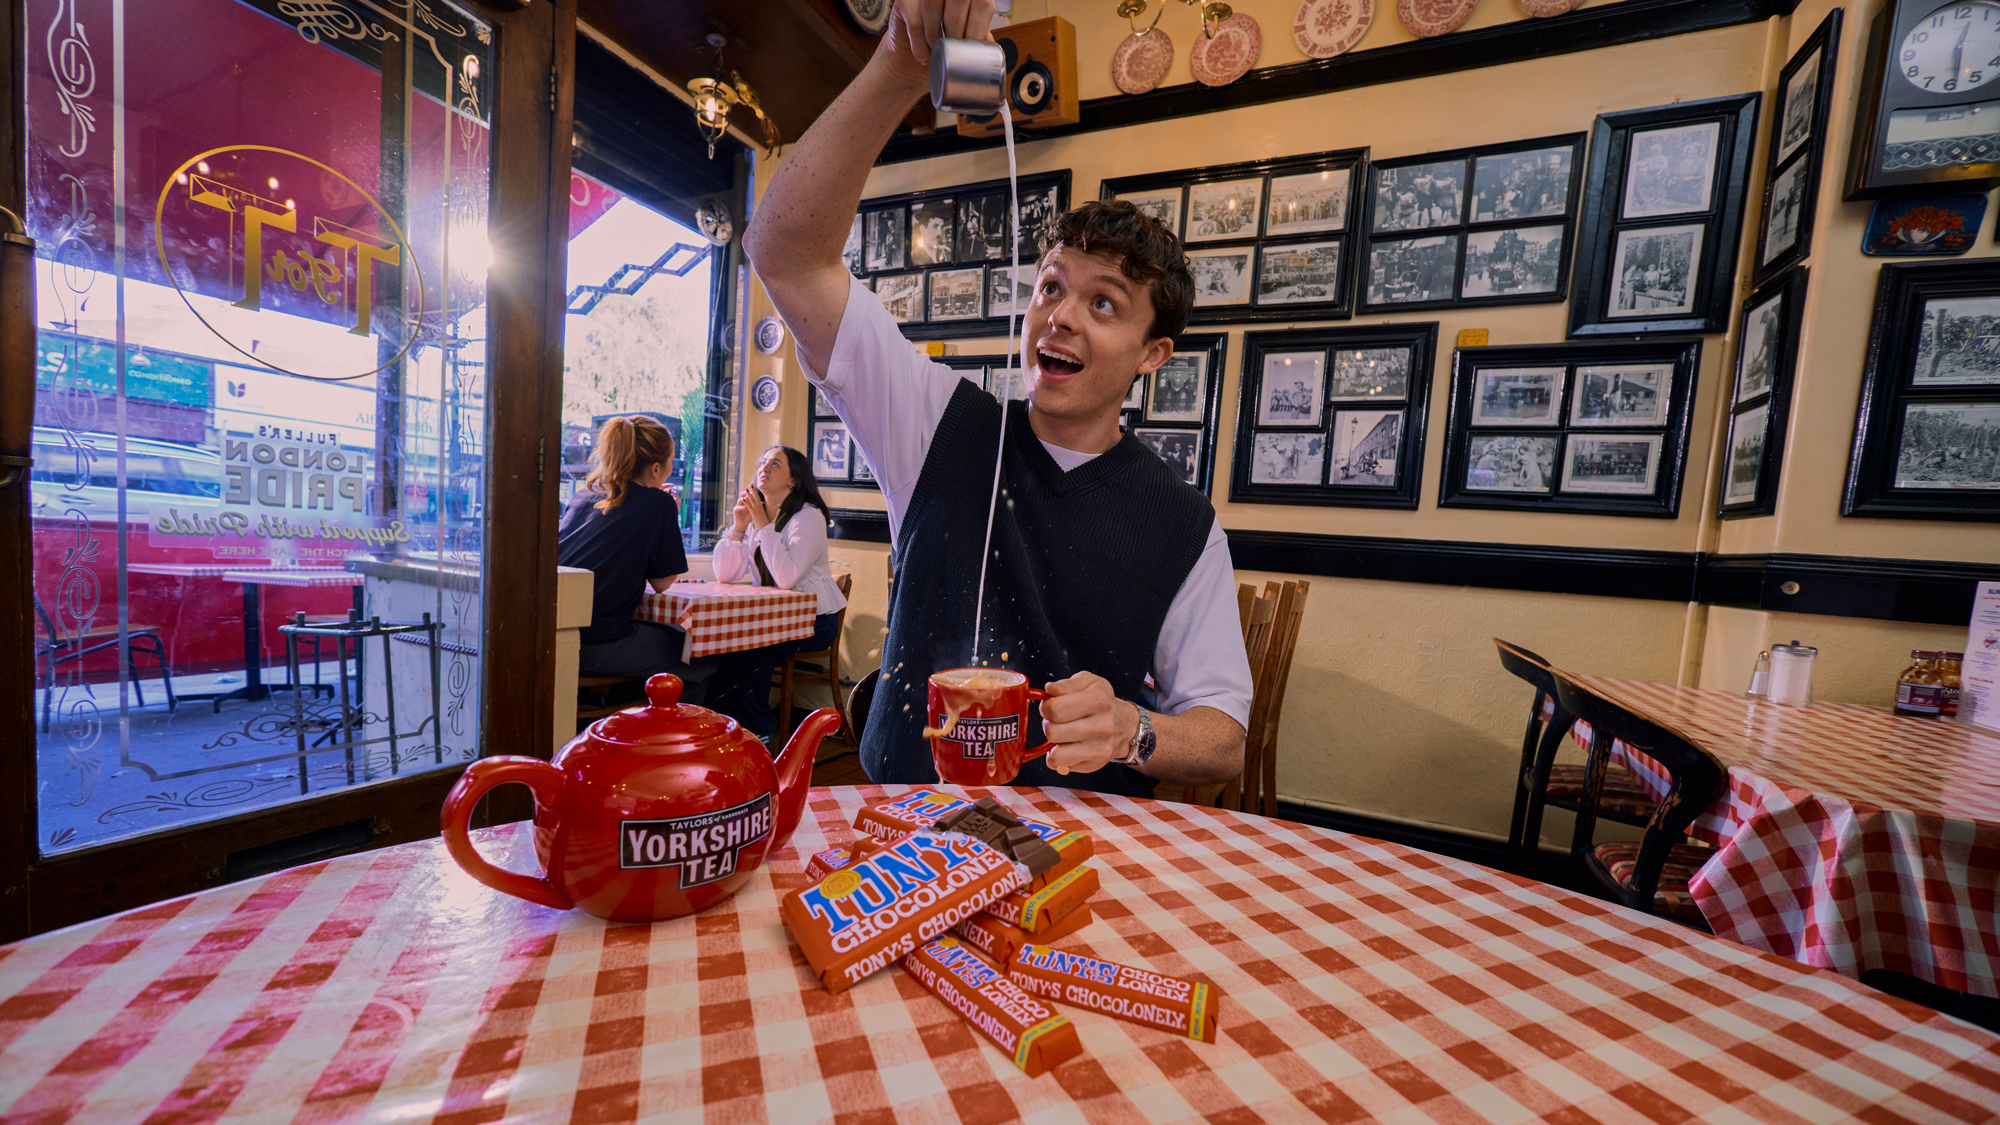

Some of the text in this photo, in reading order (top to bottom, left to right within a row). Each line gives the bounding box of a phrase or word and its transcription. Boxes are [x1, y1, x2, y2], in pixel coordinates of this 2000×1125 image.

[1931, 15, 1945, 28] 11
[1955, 7, 1972, 20] 12
[1983, 9, 1989, 21] 1
[1911, 31, 1929, 44] 10
[1902, 49, 1916, 61] 9
[1907, 65, 1919, 78] 8
[1969, 70, 1983, 83] 5
[1923, 76, 1936, 88] 7
[1944, 79, 1957, 91] 6
[964, 741, 993, 757] TEA
[669, 816, 714, 831] TAYLORS
[721, 807, 749, 820] HARROGATE
[628, 805, 770, 863] YORKSHIRE
[686, 850, 733, 884] TEA
[831, 848, 1009, 953] CHOCOLONE
[844, 932, 915, 984] TONY'S
[905, 952, 936, 988] TONY'S
[1017, 943, 1191, 992] TONY'S CHOCO
[921, 934, 1002, 989] TONY'S
[994, 977, 1050, 1019] CHOCO
[1010, 970, 1062, 999] TONY'S
